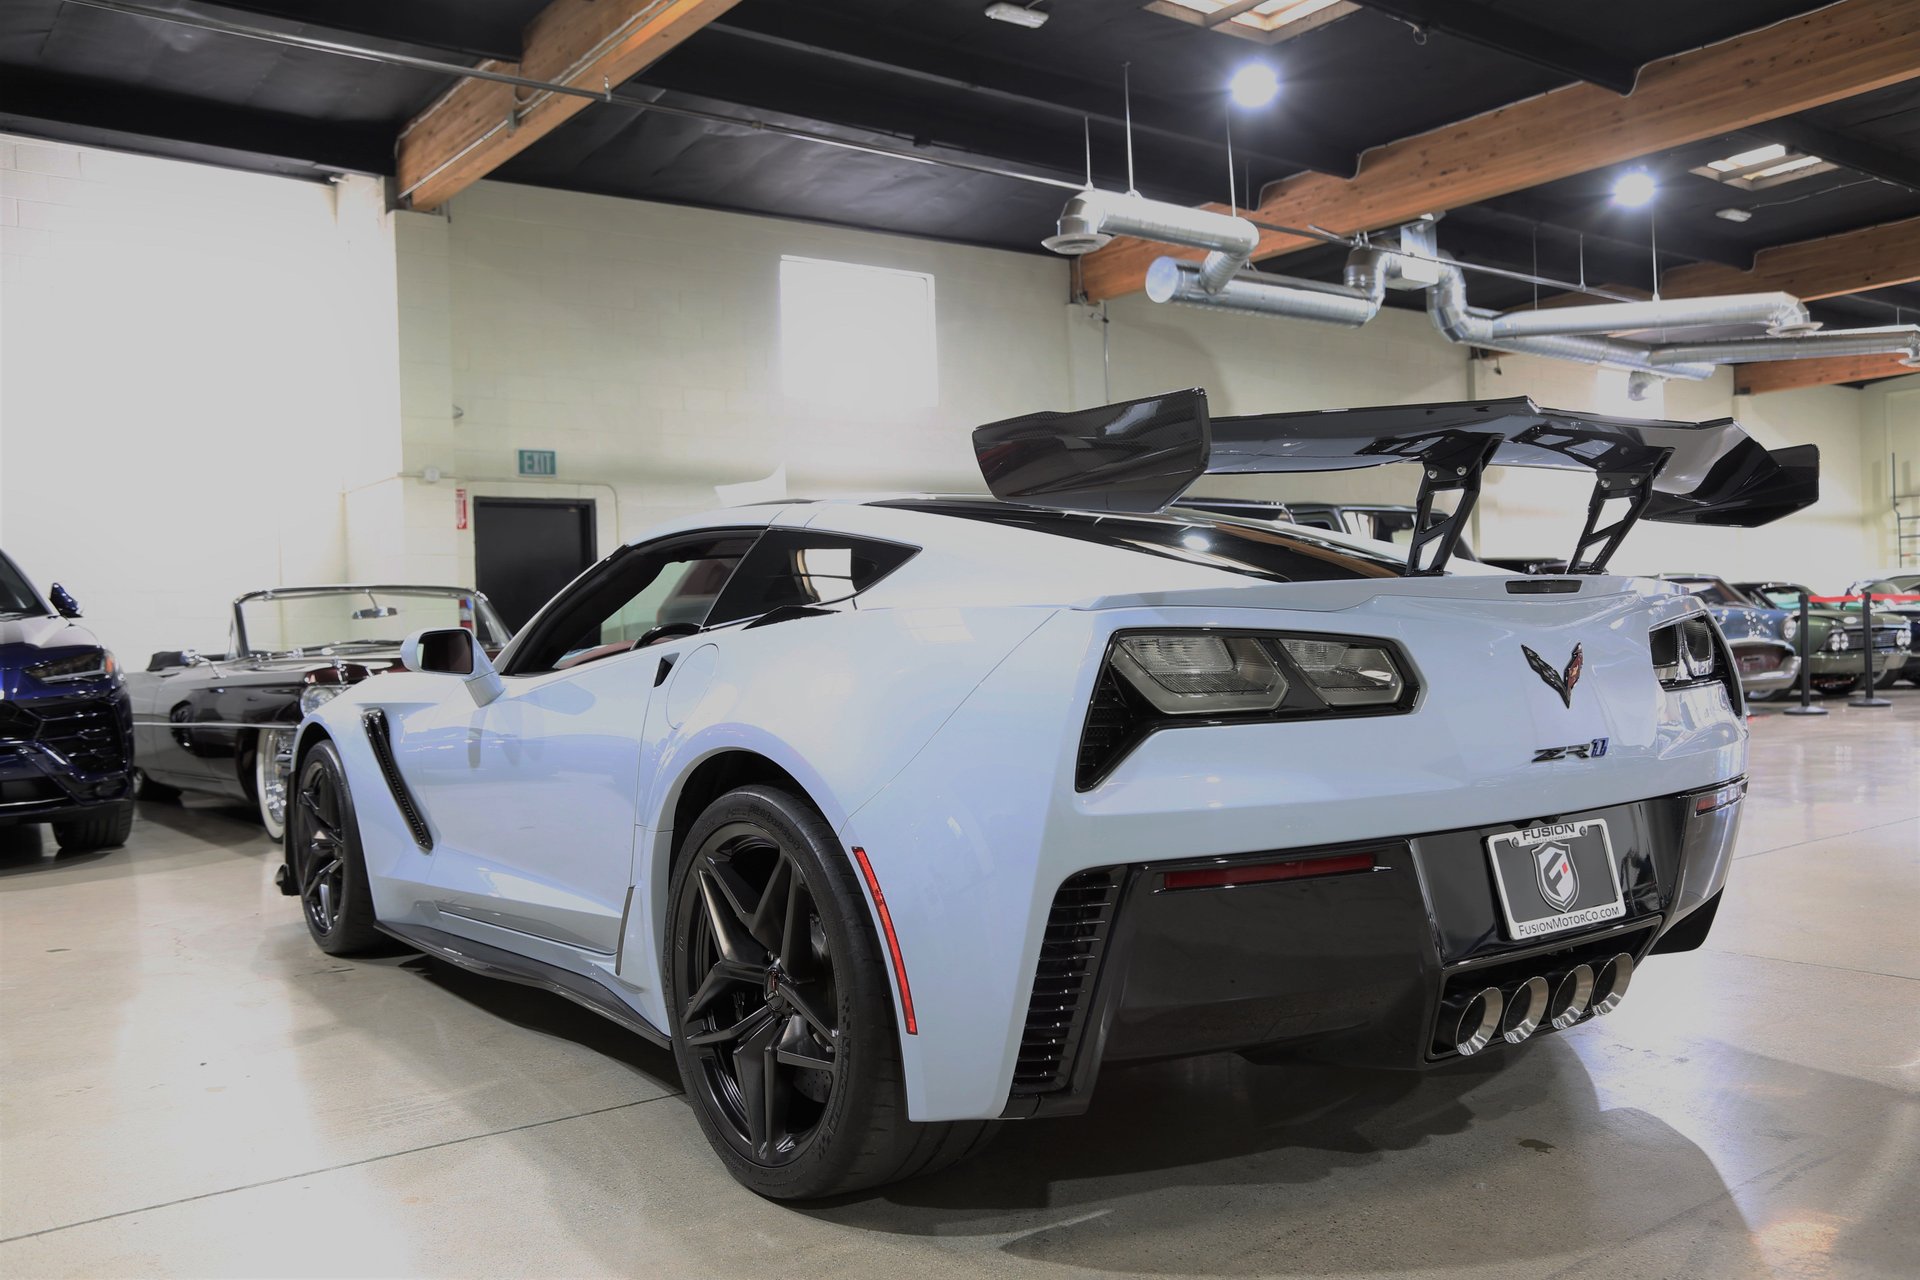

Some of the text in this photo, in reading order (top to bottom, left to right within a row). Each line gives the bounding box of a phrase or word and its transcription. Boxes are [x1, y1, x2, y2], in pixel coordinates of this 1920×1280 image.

[524, 452, 553, 473] EXIT
[1531, 737, 1609, 763] ZR1
[1522, 824, 1575, 840] FUSION
